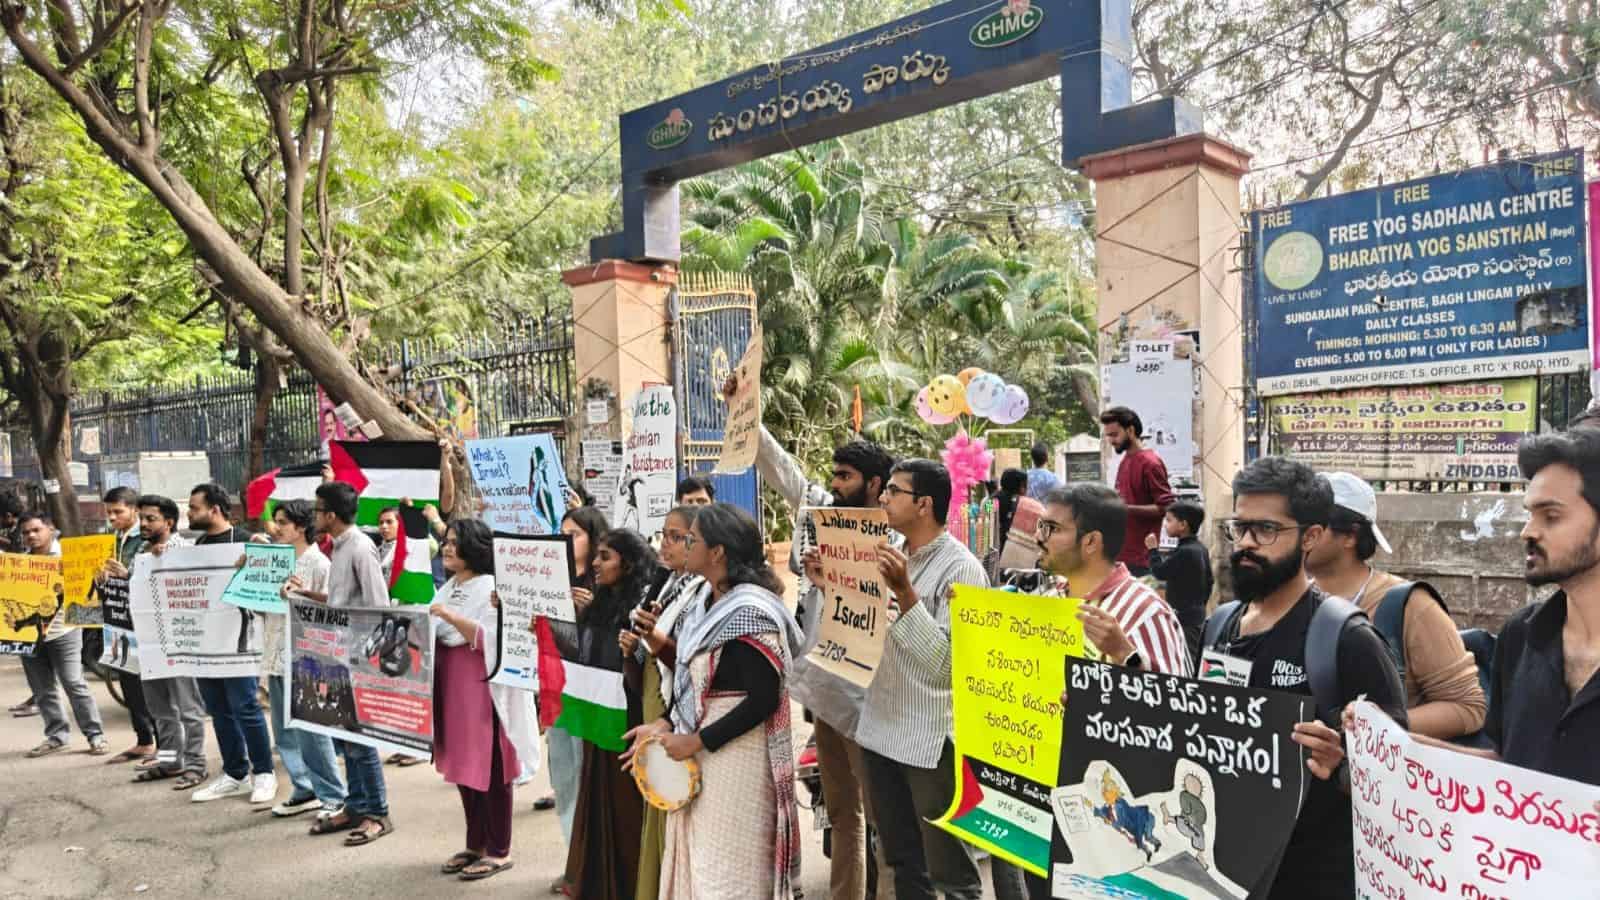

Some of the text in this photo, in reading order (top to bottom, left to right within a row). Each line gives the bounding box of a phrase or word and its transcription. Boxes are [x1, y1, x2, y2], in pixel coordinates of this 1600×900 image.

[977, 9, 1035, 43] GHMC
[708, 50, 953, 142] సుందరయ్య పార్కు
[650, 118, 689, 145] GHMC
[1534, 157, 1575, 178] FREE
[1394, 184, 1431, 205] FREE
[1261, 210, 1292, 230] FREE
[1329, 187, 1574, 246] FREE YOG SADHANA CENTRE
[1329, 241, 1413, 271] BHARATIYA
[1418, 236, 1451, 257] YOG
[1455, 221, 1547, 252] SANSTHAN
[1344, 269, 1418, 296] భారతీయ
[1422, 262, 1480, 284] యోగా
[1285, 306, 1349, 325] SUNDARAIAH
[1351, 303, 1379, 316] PARK
[1432, 292, 1463, 306] BAGH
[1467, 287, 1513, 302] LINGAM
[1366, 311, 1456, 331] DAILY CLASSES
[1315, 320, 1517, 351] TIMINGS: MORNING: 5.30 TO 6.30 AM
[1295, 354, 1342, 368] EVENING:
[1344, 352, 1365, 363] 5.00
[1368, 350, 1382, 360] TO
[1385, 348, 1407, 359] 6.00
[1410, 346, 1426, 357] PM
[1437, 343, 1467, 355] ONLY
[1470, 340, 1494, 352] FOR
[1497, 336, 1540, 350] LADIES
[1330, 372, 1368, 384] BRANCH
[1473, 363, 1495, 373] RTC
[649, 392, 671, 417] the
[1433, 399, 1527, 413] ఉచితం
[475, 462, 511, 480] Israel?
[1445, 463, 1519, 478] ZINDABA
[818, 509, 889, 537] Indian State
[184, 576, 208, 587] PEOPLE
[832, 596, 877, 636] Israel!
[1271, 659, 1303, 675] FOCUS
[1118, 673, 1162, 708] ఆఫ్
[1224, 696, 1267, 729] ఒక
[1085, 711, 1282, 790] వలసవాద పన్నాగం!
[1472, 835, 1542, 884] పైగా
